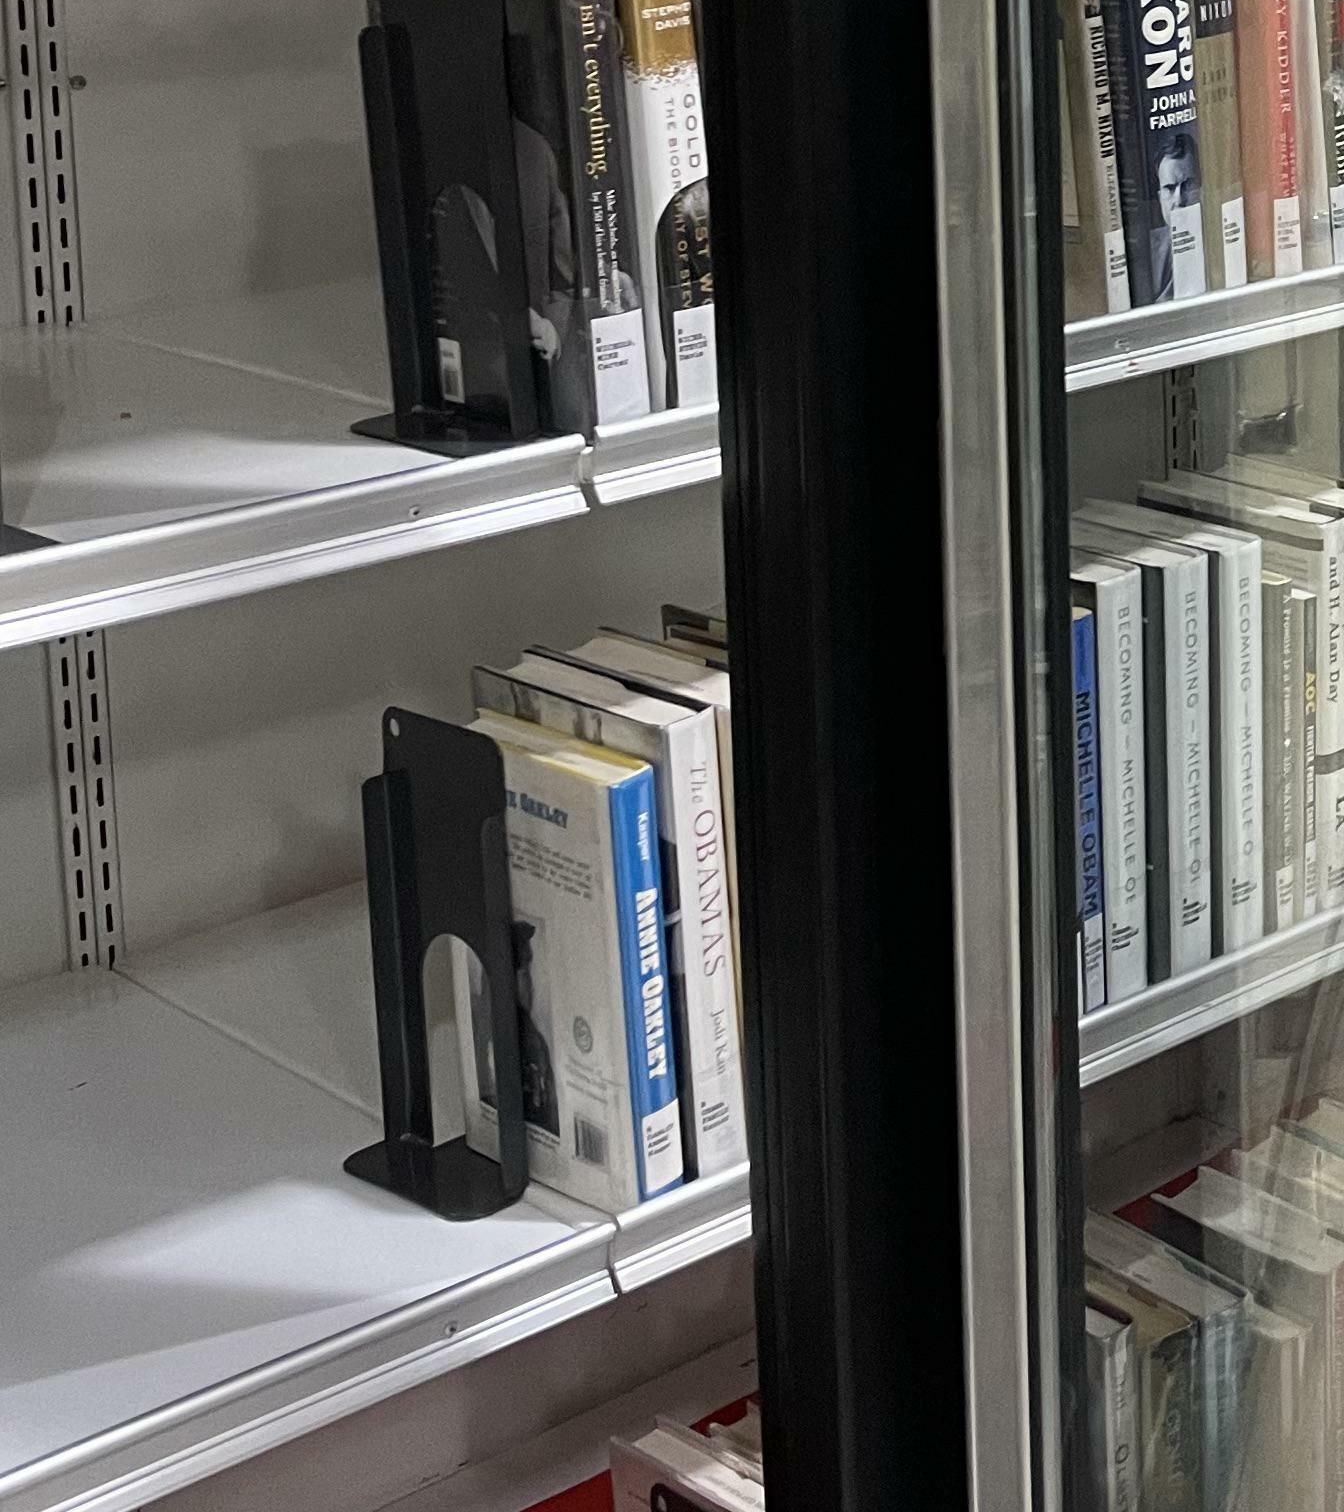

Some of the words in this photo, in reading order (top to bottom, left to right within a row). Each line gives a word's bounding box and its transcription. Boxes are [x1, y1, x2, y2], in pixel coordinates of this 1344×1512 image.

[580, 2, 603, 52] isn't
[654, 15, 690, 31] DAVIS
[1089, 23, 1111, 85] RICHARD
[1095, 92, 1109, 111] M.
[1151, 91, 1186, 112] JOHN
[1276, 29, 1292, 114] KIDDER
[580, 58, 612, 180] everything.
[683, 92, 702, 169] GOLD
[1098, 114, 1115, 159] NIXON
[664, 97, 678, 131] THE
[676, 239, 690, 262] OF
[1329, 556, 1341, 590] and
[1329, 595, 1341, 617] H.
[1117, 605, 1133, 725] BECOMING
[1184, 590, 1199, 709] BECOMING
[1238, 576, 1253, 693] BECOMING
[1329, 622, 1341, 665] Alan
[1305, 672, 1317, 714] AOC
[1328, 670, 1340, 703] Day
[690, 764, 705, 804] The
[1075, 691, 1096, 826] MICHELLE
[1187, 742, 1201, 849] MICHELLE
[1240, 725, 1254, 830] MICHELLE
[1121, 759, 1136, 867] MICHELLE
[694, 809, 726, 978] OBAMAS
[1081, 833, 1099, 917] OBAM
[635, 887, 660, 976] ANNIE
[641, 974, 667, 1081] OAKLEY
